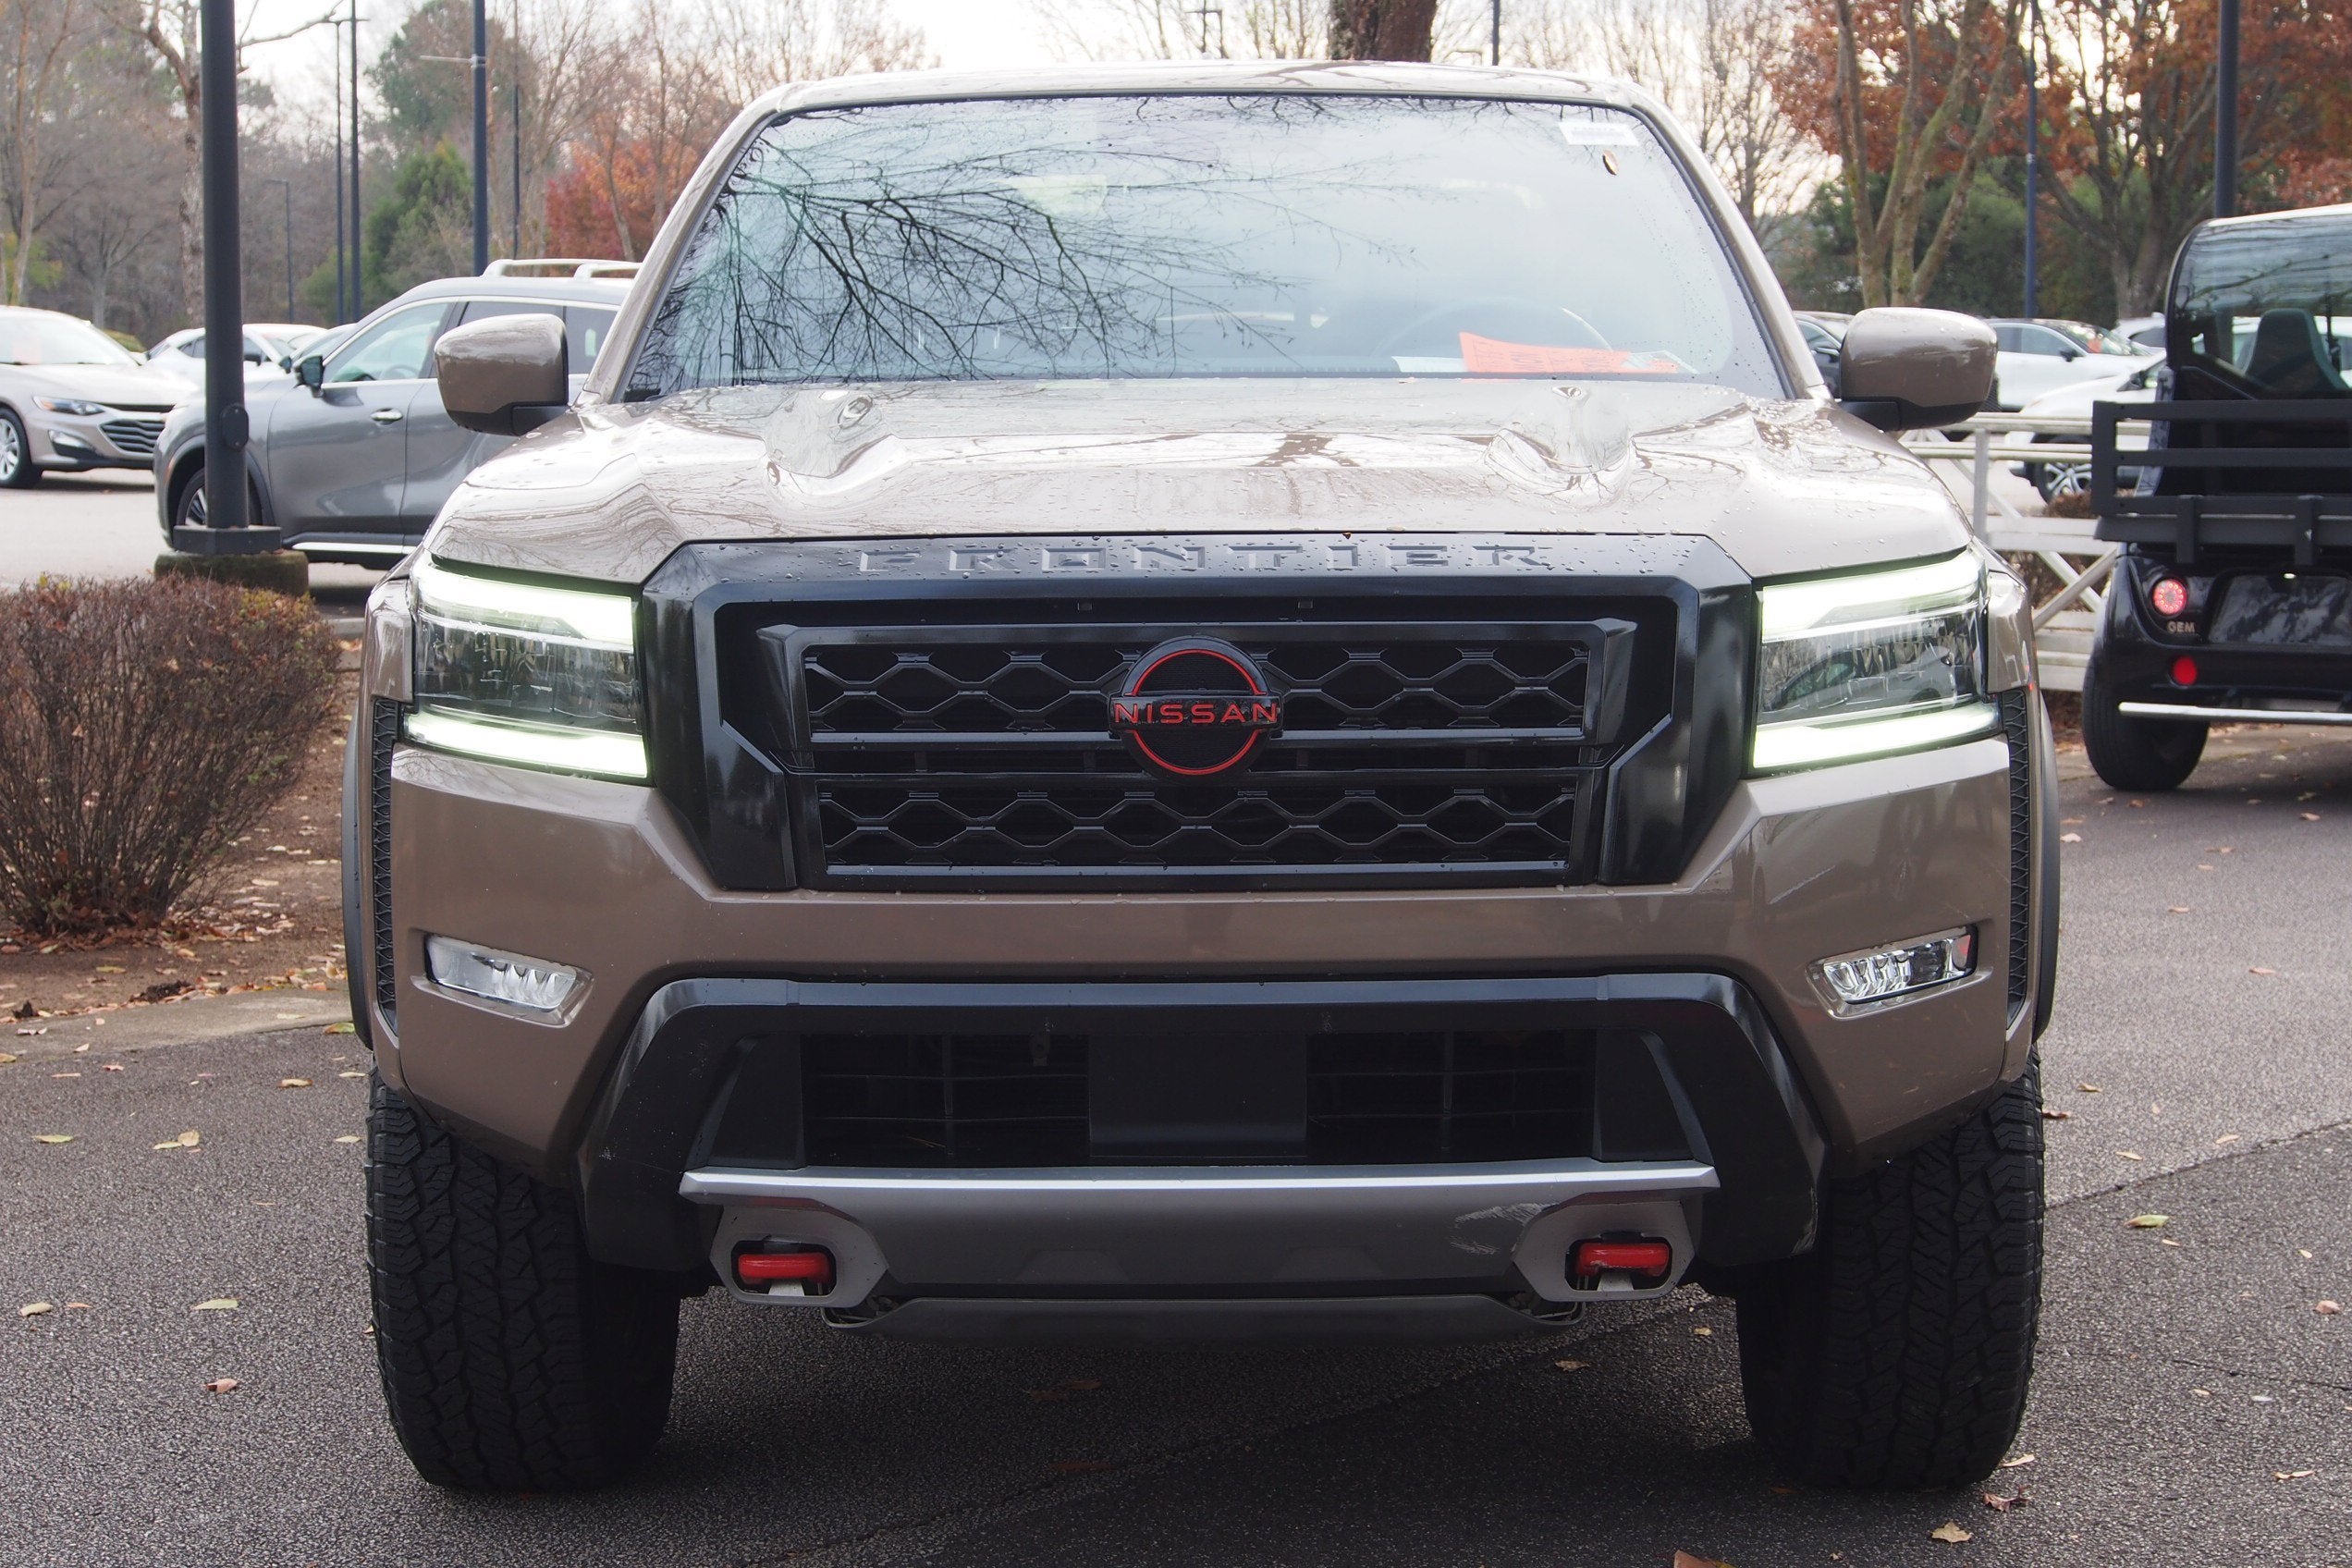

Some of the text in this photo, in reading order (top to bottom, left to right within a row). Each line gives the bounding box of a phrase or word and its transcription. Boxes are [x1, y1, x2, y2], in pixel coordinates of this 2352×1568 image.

[860, 545, 1550, 572] FRONTIER
[2167, 620, 2196, 634] GEM
[1114, 703, 1278, 724] NISSAN
